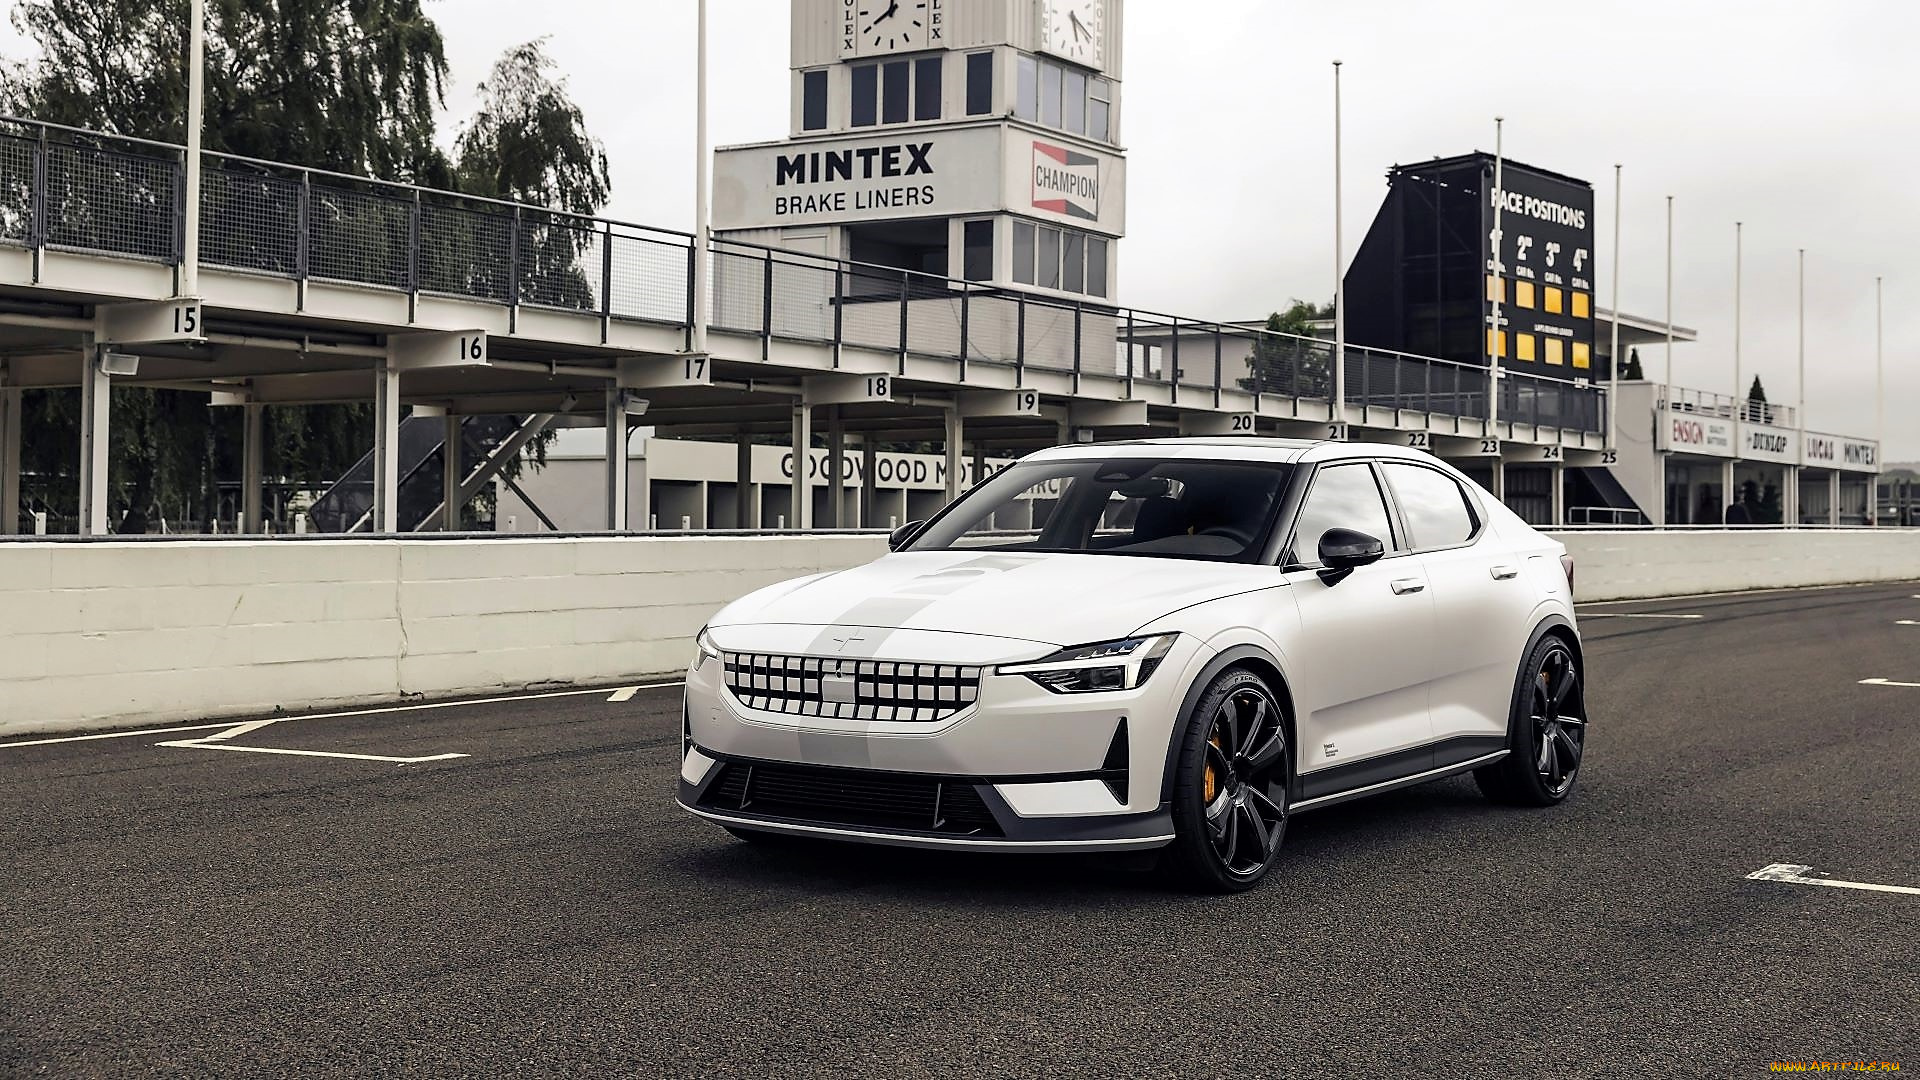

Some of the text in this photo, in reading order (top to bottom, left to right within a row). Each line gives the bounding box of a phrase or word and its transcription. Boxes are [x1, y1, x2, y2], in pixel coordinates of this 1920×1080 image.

[776, 142, 934, 186] MINTEX
[1036, 165, 1096, 200] CHAMPION
[775, 185, 935, 215] BRAKE LINERS
[1524, 196, 1586, 230] POSITIONS
[174, 306, 196, 333] 15
[461, 336, 482, 360] 16
[685, 359, 706, 379] 17
[867, 377, 887, 397] 18
[1017, 393, 1035, 411] 19
[1232, 415, 1251, 430] 20
[1329, 425, 1345, 439] 21
[1673, 419, 1704, 445] ENSIGN
[1408, 433, 1426, 446] 22
[1481, 440, 1497, 453] 23
[1753, 431, 1787, 453] DUNLOP
[1807, 438, 1834, 460] LUCAS
[1543, 447, 1559, 459] 24
[1601, 452, 1617, 464] 25
[1844, 442, 1876, 465] MINTEX
